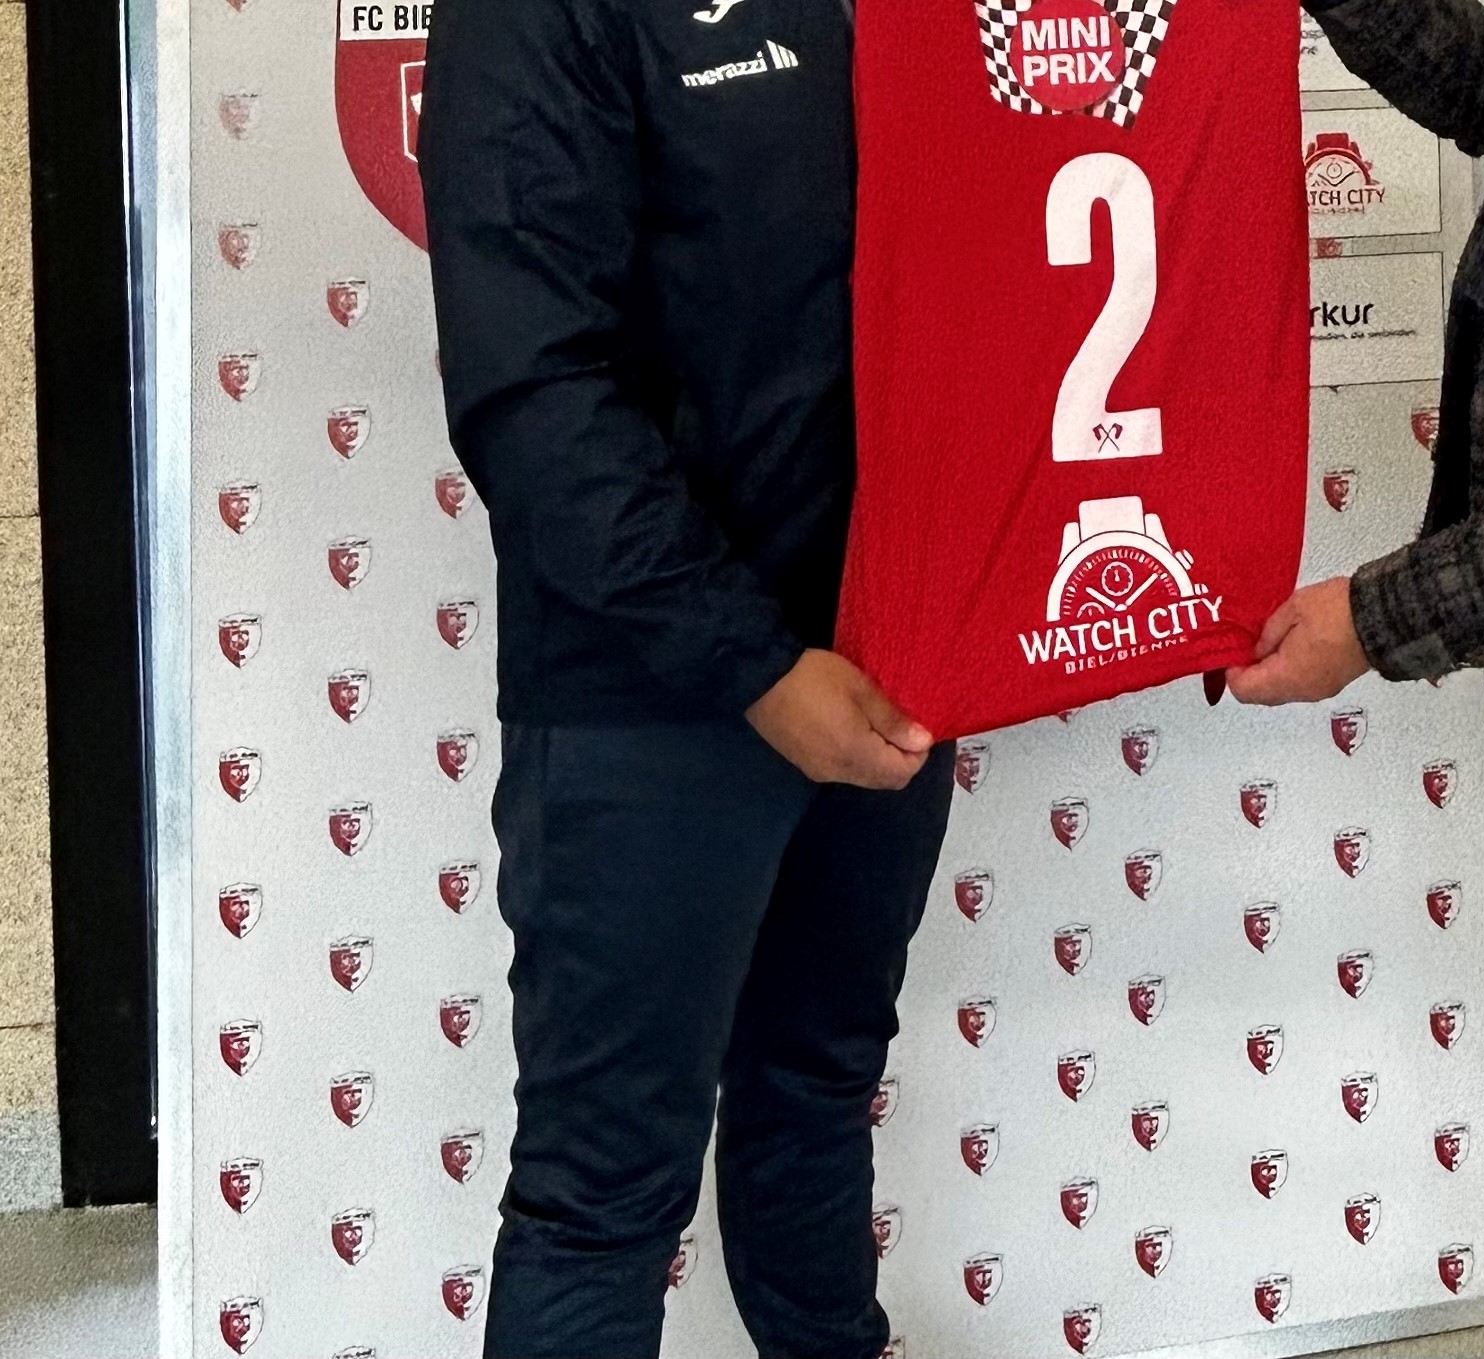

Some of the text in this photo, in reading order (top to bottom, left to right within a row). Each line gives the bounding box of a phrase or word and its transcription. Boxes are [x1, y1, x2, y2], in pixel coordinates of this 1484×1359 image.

[353, 5, 383, 31] FC
[1021, 15, 1110, 50] MINI
[681, 51, 768, 87] merazzi
[1023, 51, 1116, 87] PRIX
[1307, 188, 1385, 207] TCH CITY
[1046, 152, 1163, 462] 2
[1310, 302, 1374, 327] rkur
[1018, 595, 1223, 665] WATCH CITY
